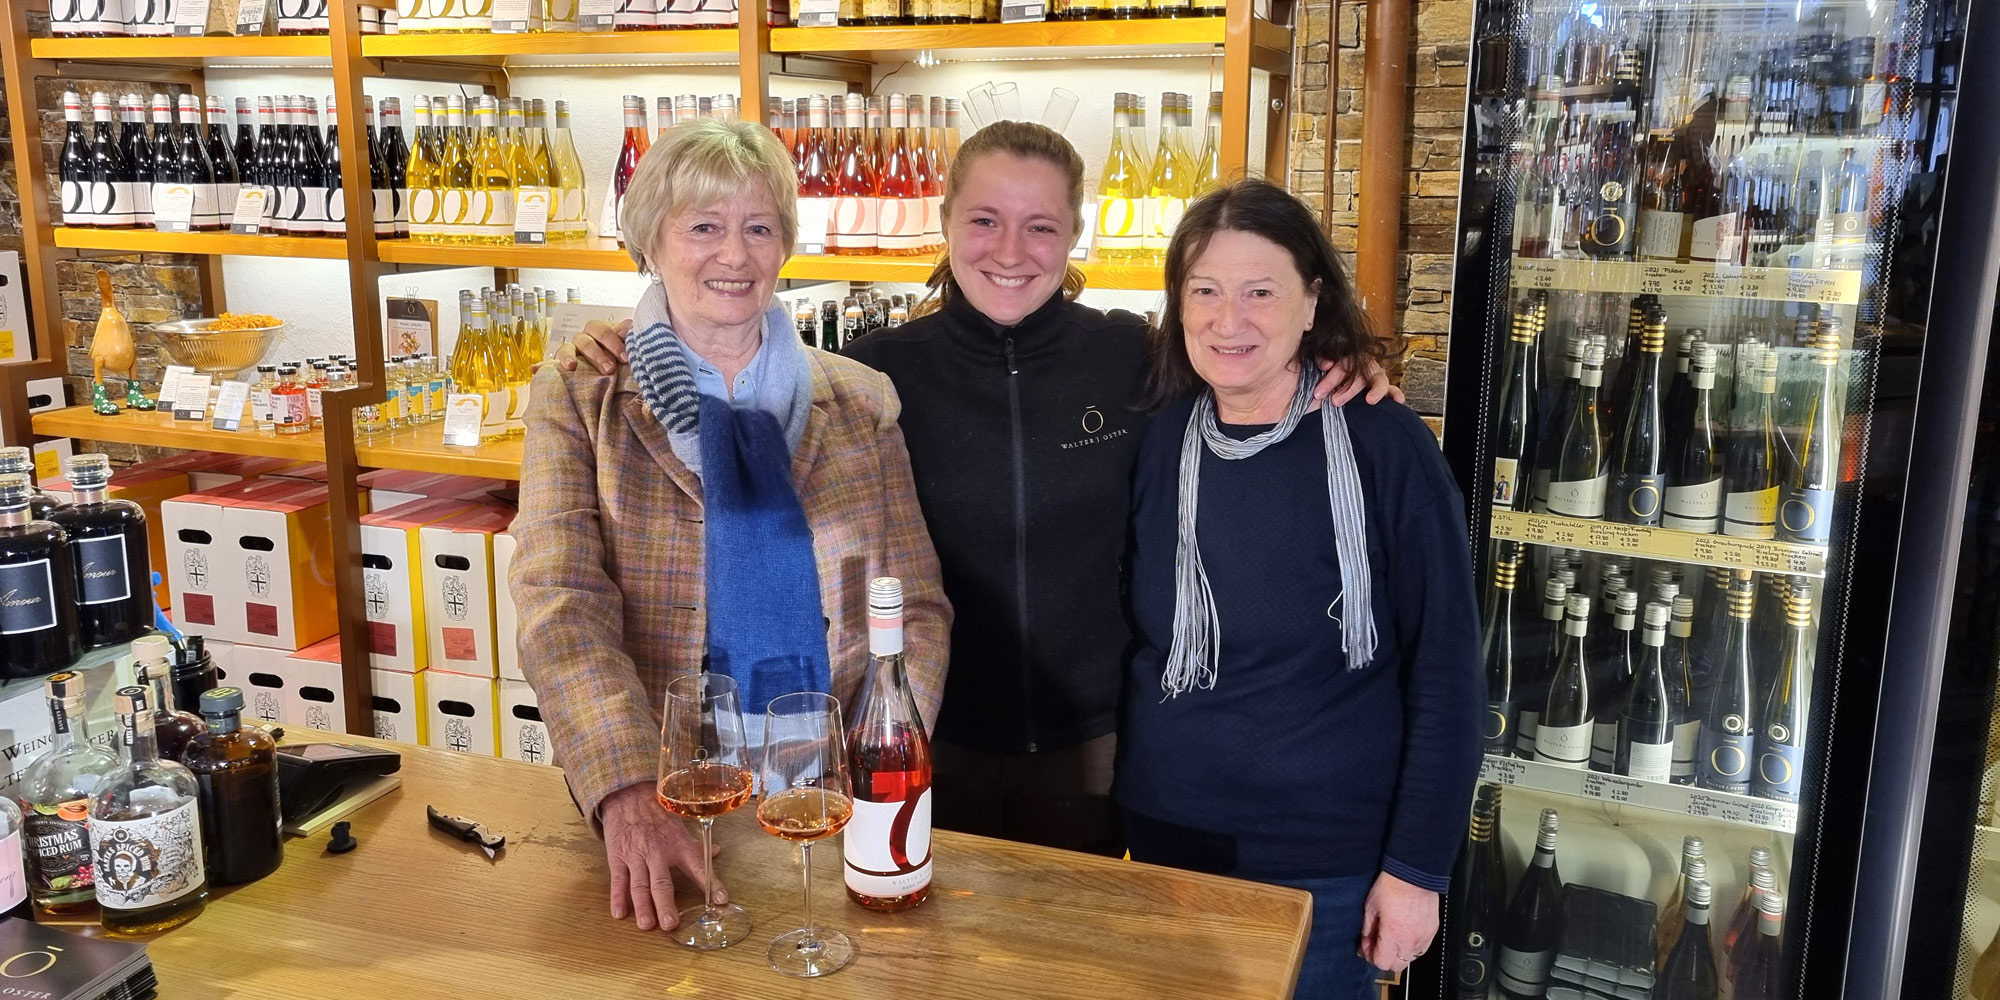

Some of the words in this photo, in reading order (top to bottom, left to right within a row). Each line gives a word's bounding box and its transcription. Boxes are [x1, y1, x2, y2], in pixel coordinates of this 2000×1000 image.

[1061, 437, 1095, 449] WALTER
[1103, 428, 1128, 441] OSTER
[59, 839, 82, 854] RUM
[116, 842, 144, 857] SPICED
[2, 987, 52, 1000] OSTER
